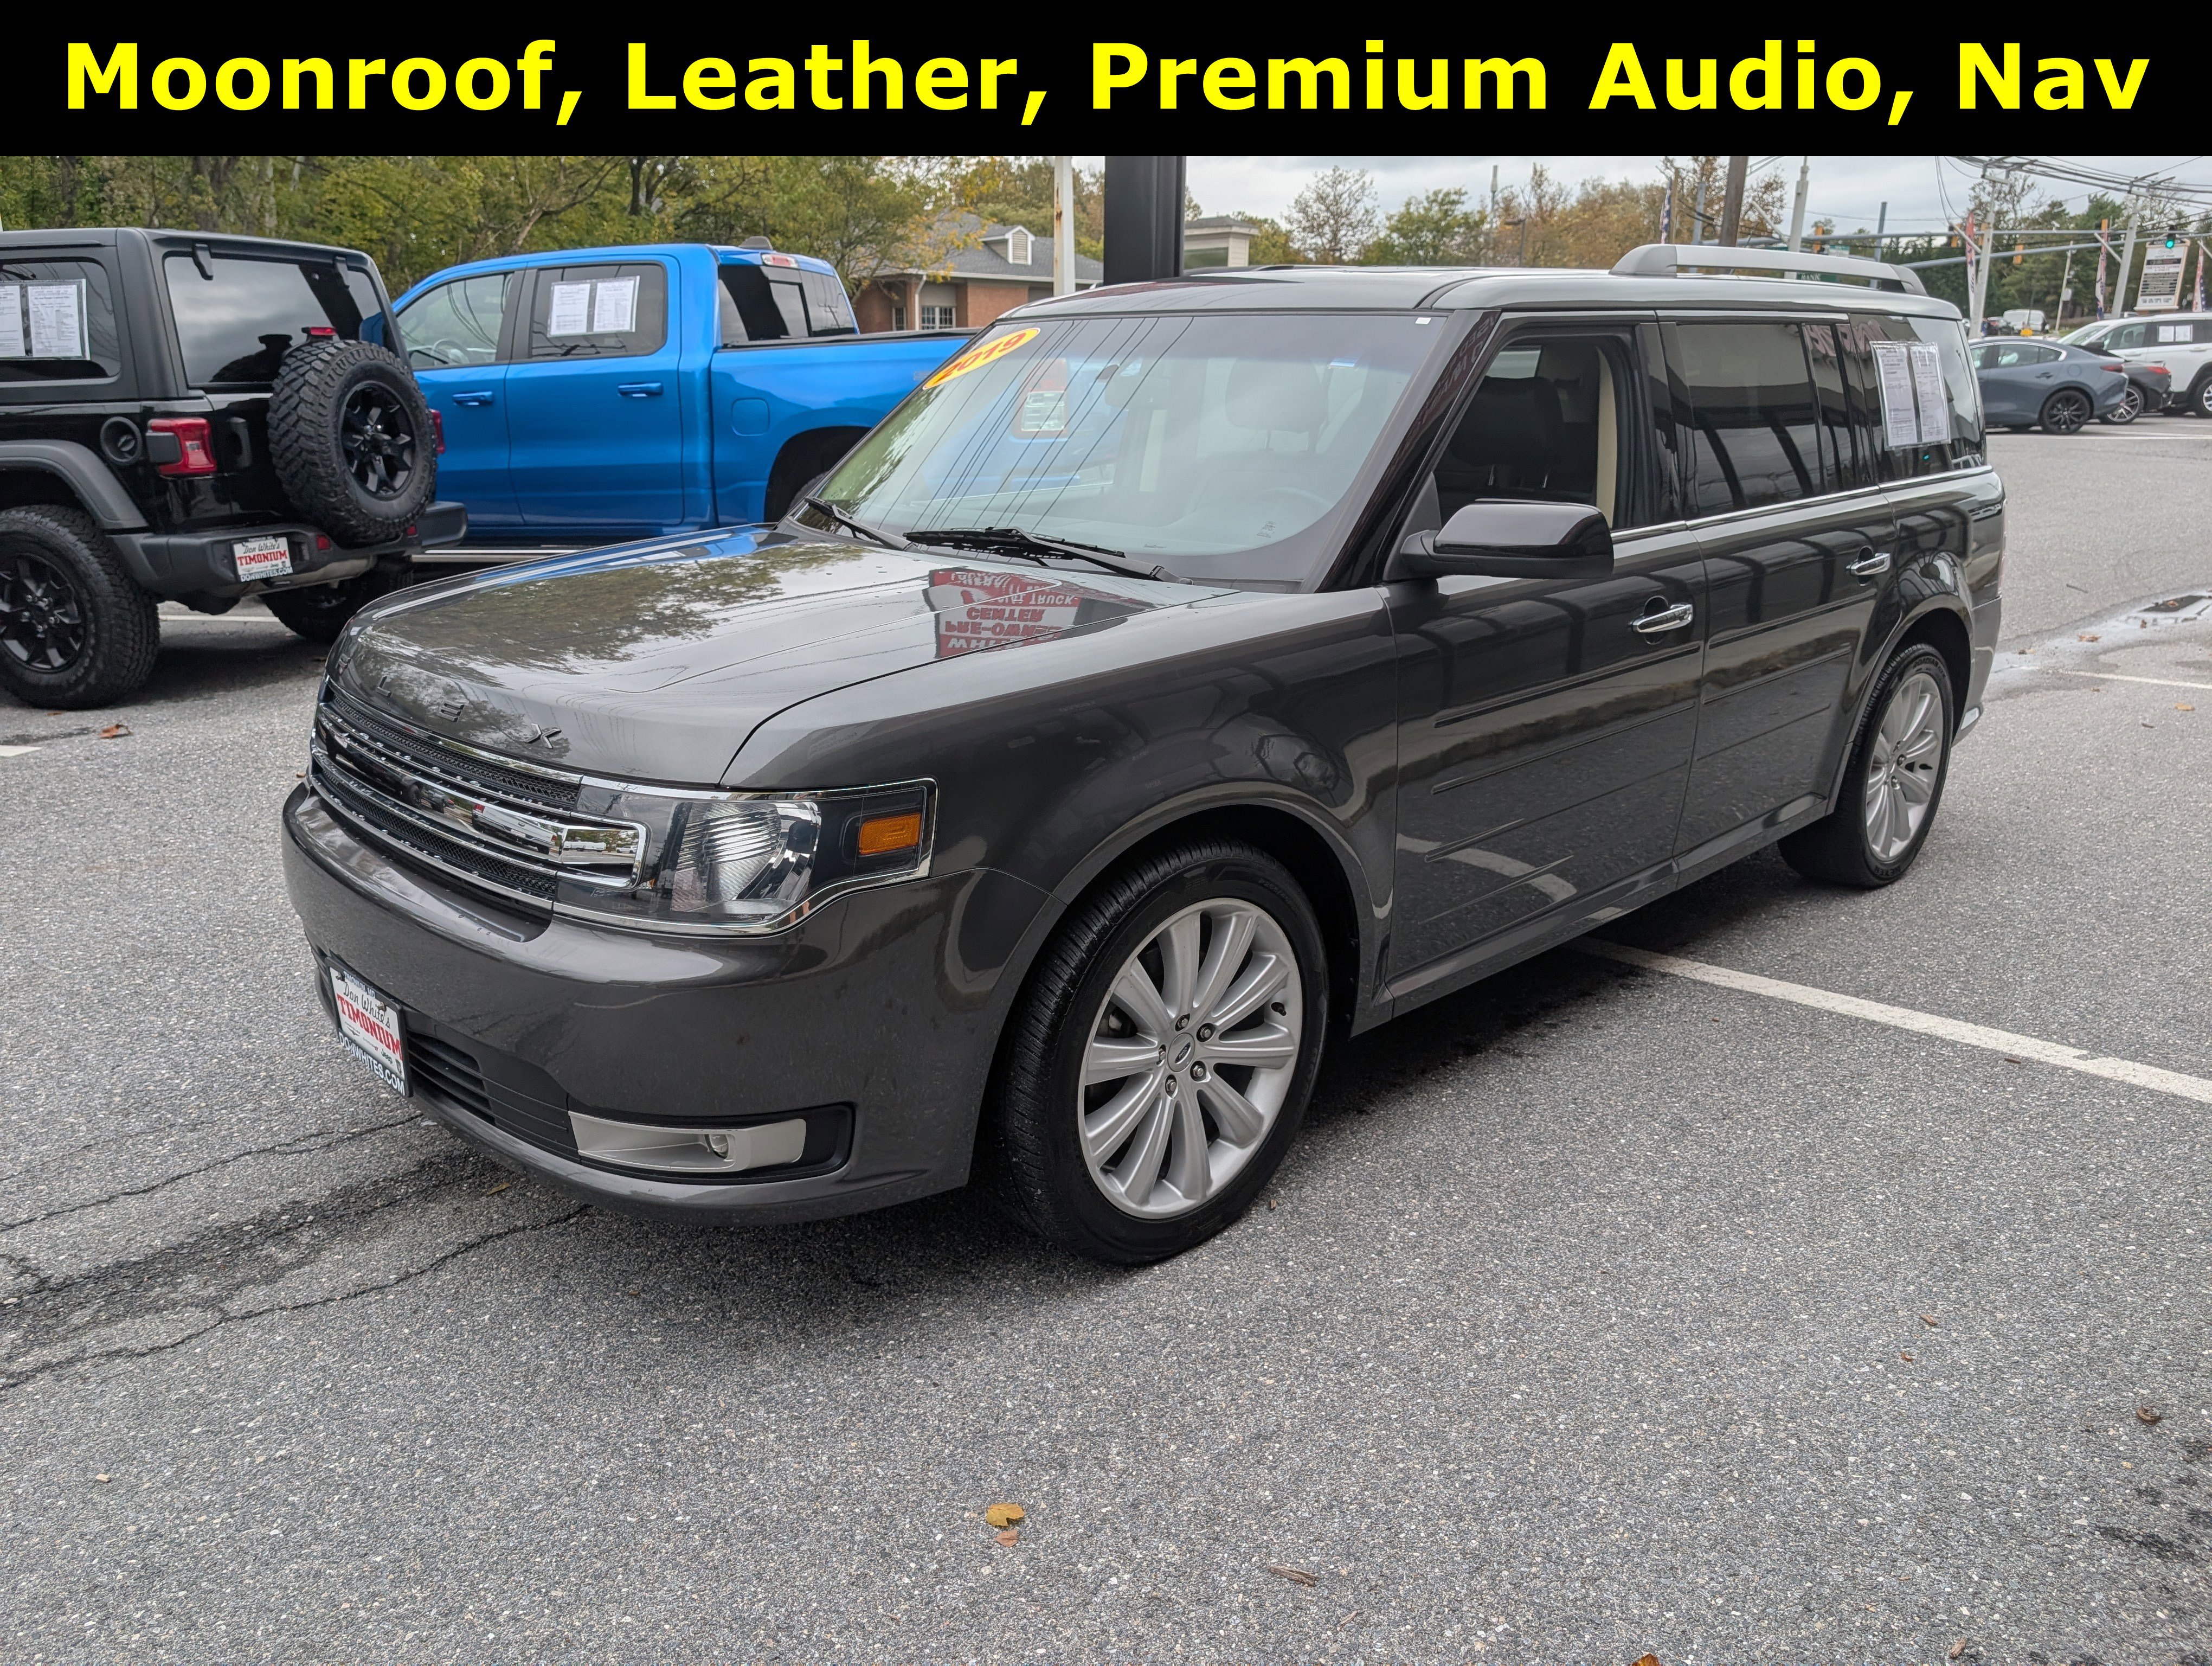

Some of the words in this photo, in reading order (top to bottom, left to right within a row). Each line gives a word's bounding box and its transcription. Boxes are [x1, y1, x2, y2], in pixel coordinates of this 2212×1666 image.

[932, 332, 1026, 385] 2019
[237, 549, 288, 566] TIMONIUM
[336, 992, 404, 1061] TIMONIUM
[343, 982, 359, 1005] Don
[361, 994, 391, 1030] White's
[338, 1031, 406, 1096] DONWHITES.COM
